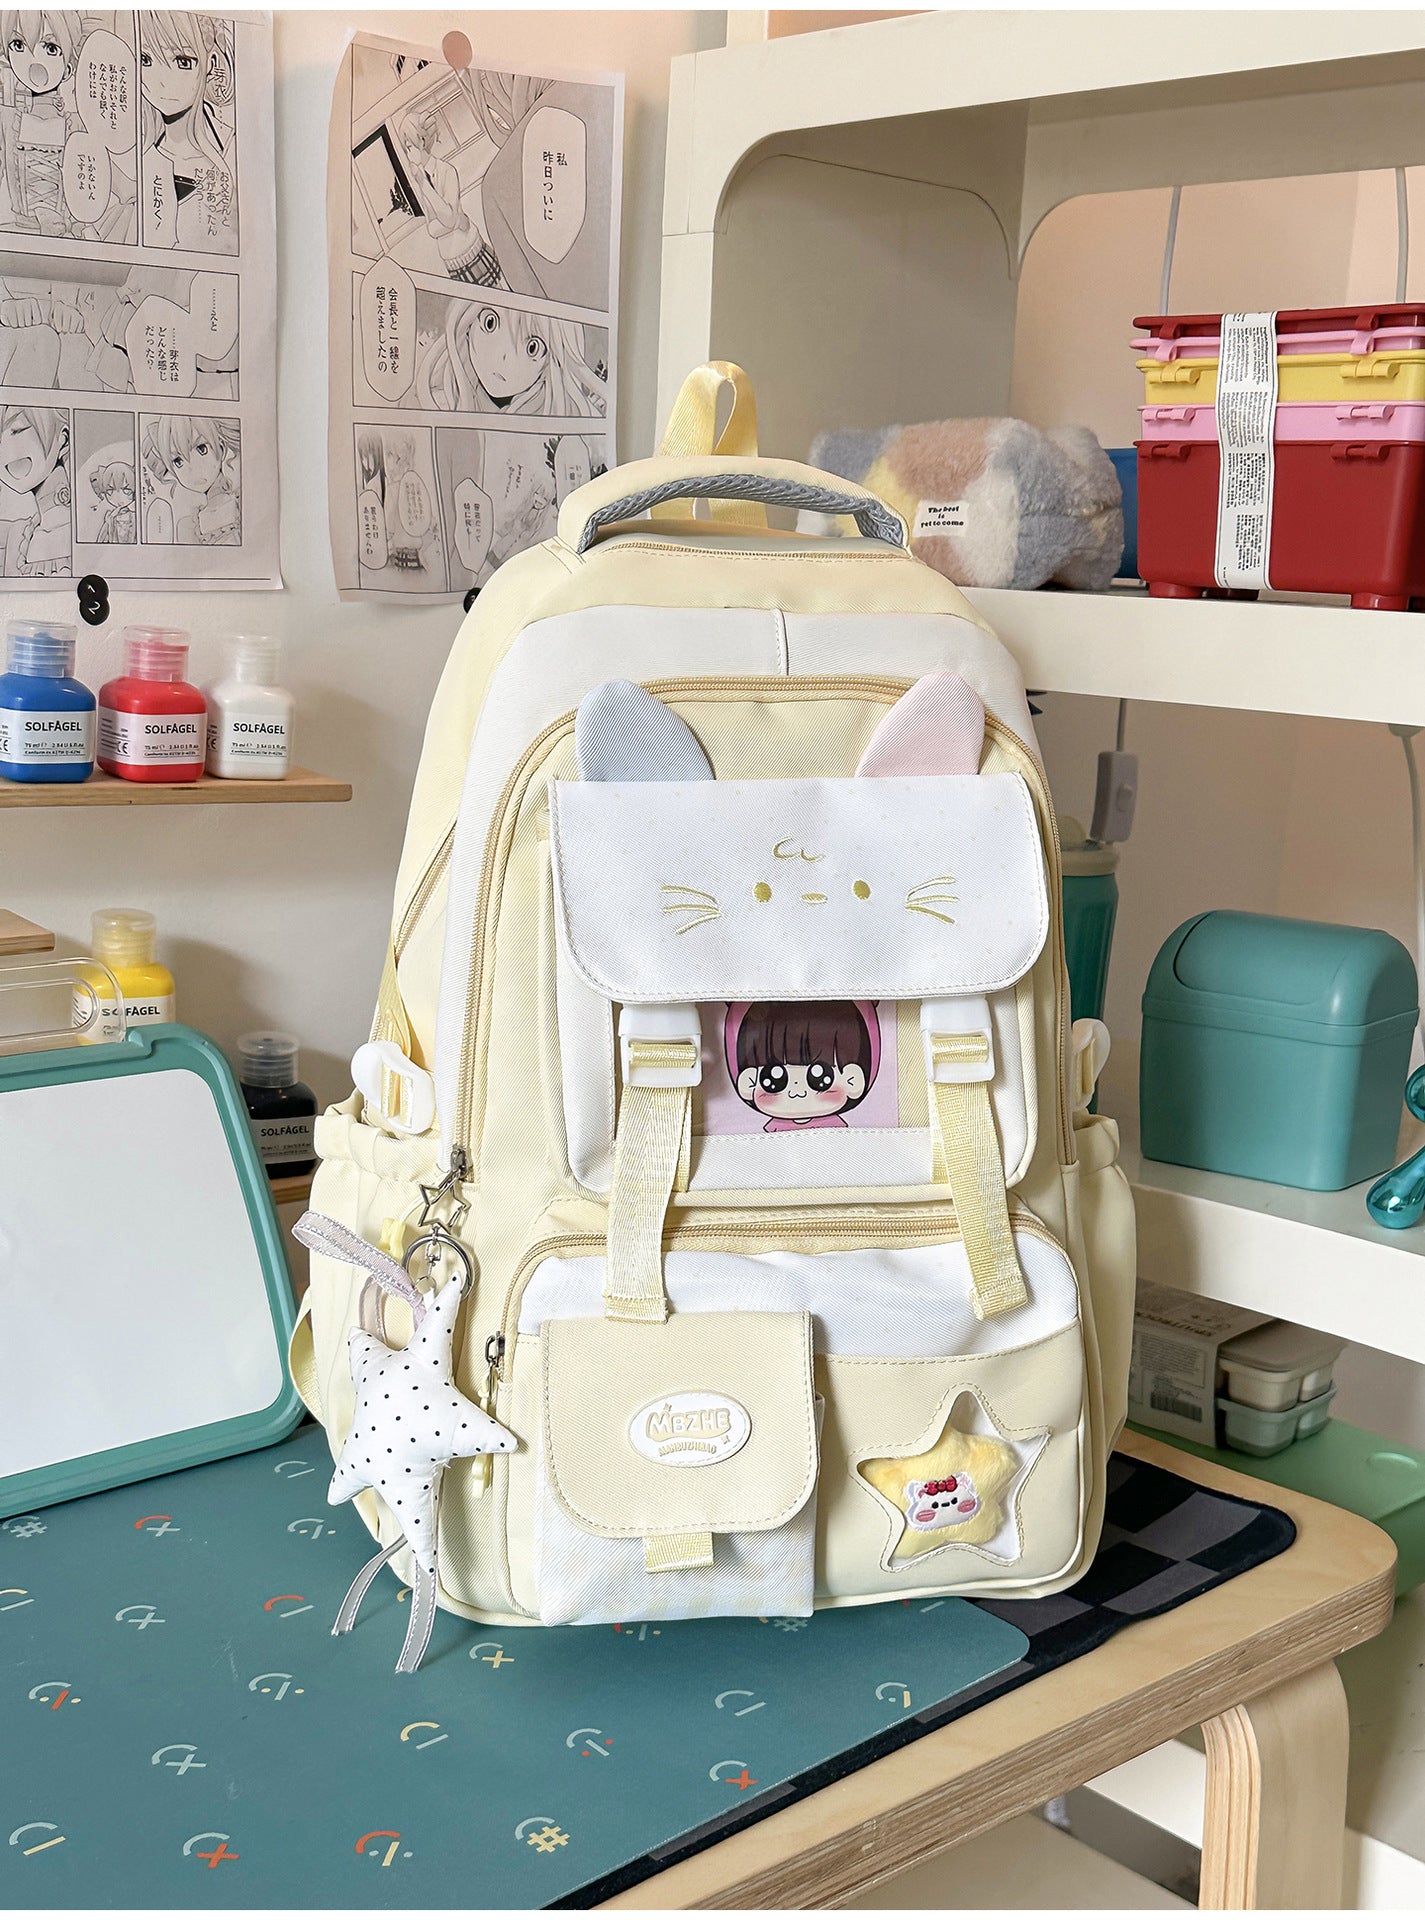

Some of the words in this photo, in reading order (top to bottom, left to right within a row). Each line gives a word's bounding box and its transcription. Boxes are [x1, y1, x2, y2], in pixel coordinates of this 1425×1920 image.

[89, 61, 98, 99] わけには
[556, 152, 568, 166] 私
[87, 155, 96, 201] いかないん
[542, 151, 554, 221] 昨日ついに
[388, 287, 400, 374] 会長と一線を
[157, 326, 168, 382] どんな感じ
[24, 720, 82, 732] SOLFÅGEL
[144, 723, 197, 734] SOLFÅGEL
[232, 722, 285, 735] SOLFÅGEL
[260, 1125, 310, 1137] SOLFÅGEL
[647, 1407, 731, 1436] MBZHE
